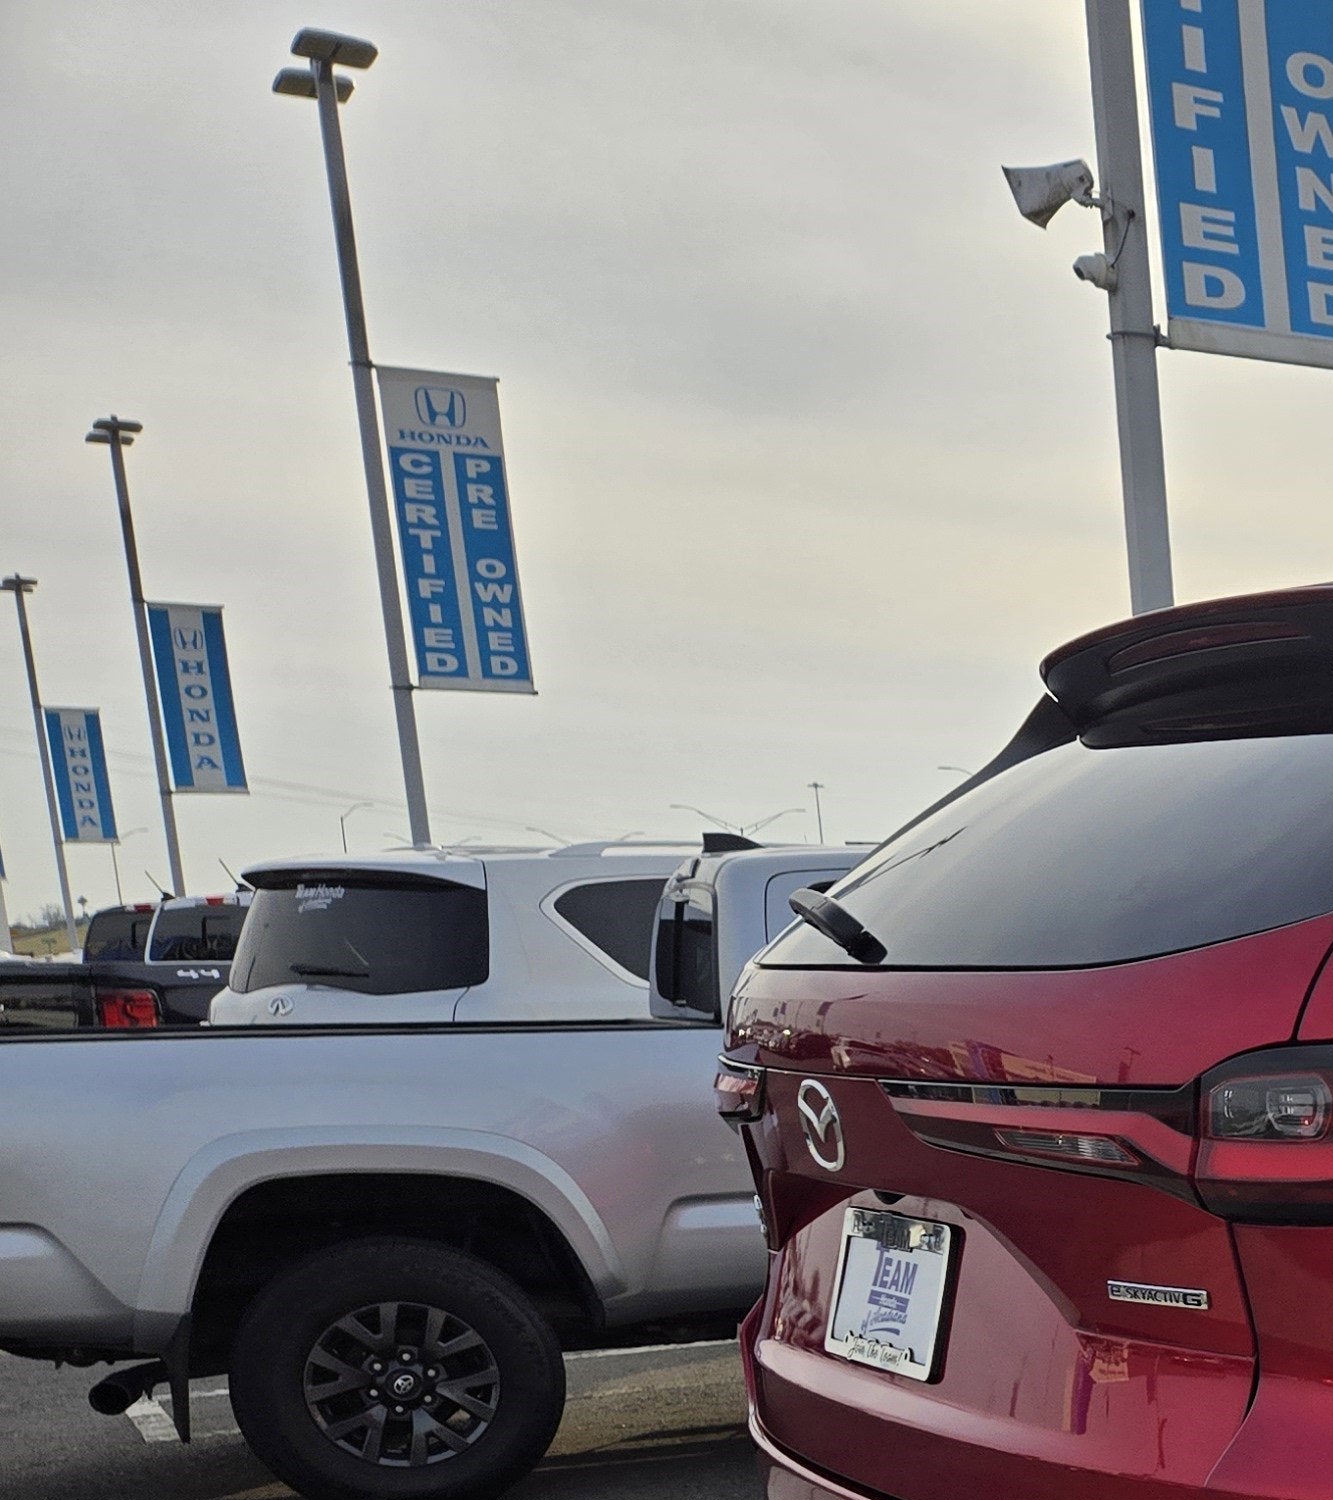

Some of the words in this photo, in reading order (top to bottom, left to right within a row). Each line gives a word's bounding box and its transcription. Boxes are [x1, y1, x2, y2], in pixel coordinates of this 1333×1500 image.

[398, 428, 490, 450] HONDA
[464, 457, 499, 532] PRE
[398, 452, 460, 676] CERTIFIED
[474, 557, 520, 678] OWNED
[179, 658, 223, 772] HONDA
[68, 747, 98, 828] HONDA
[871, 1240, 919, 1296] TEAM
